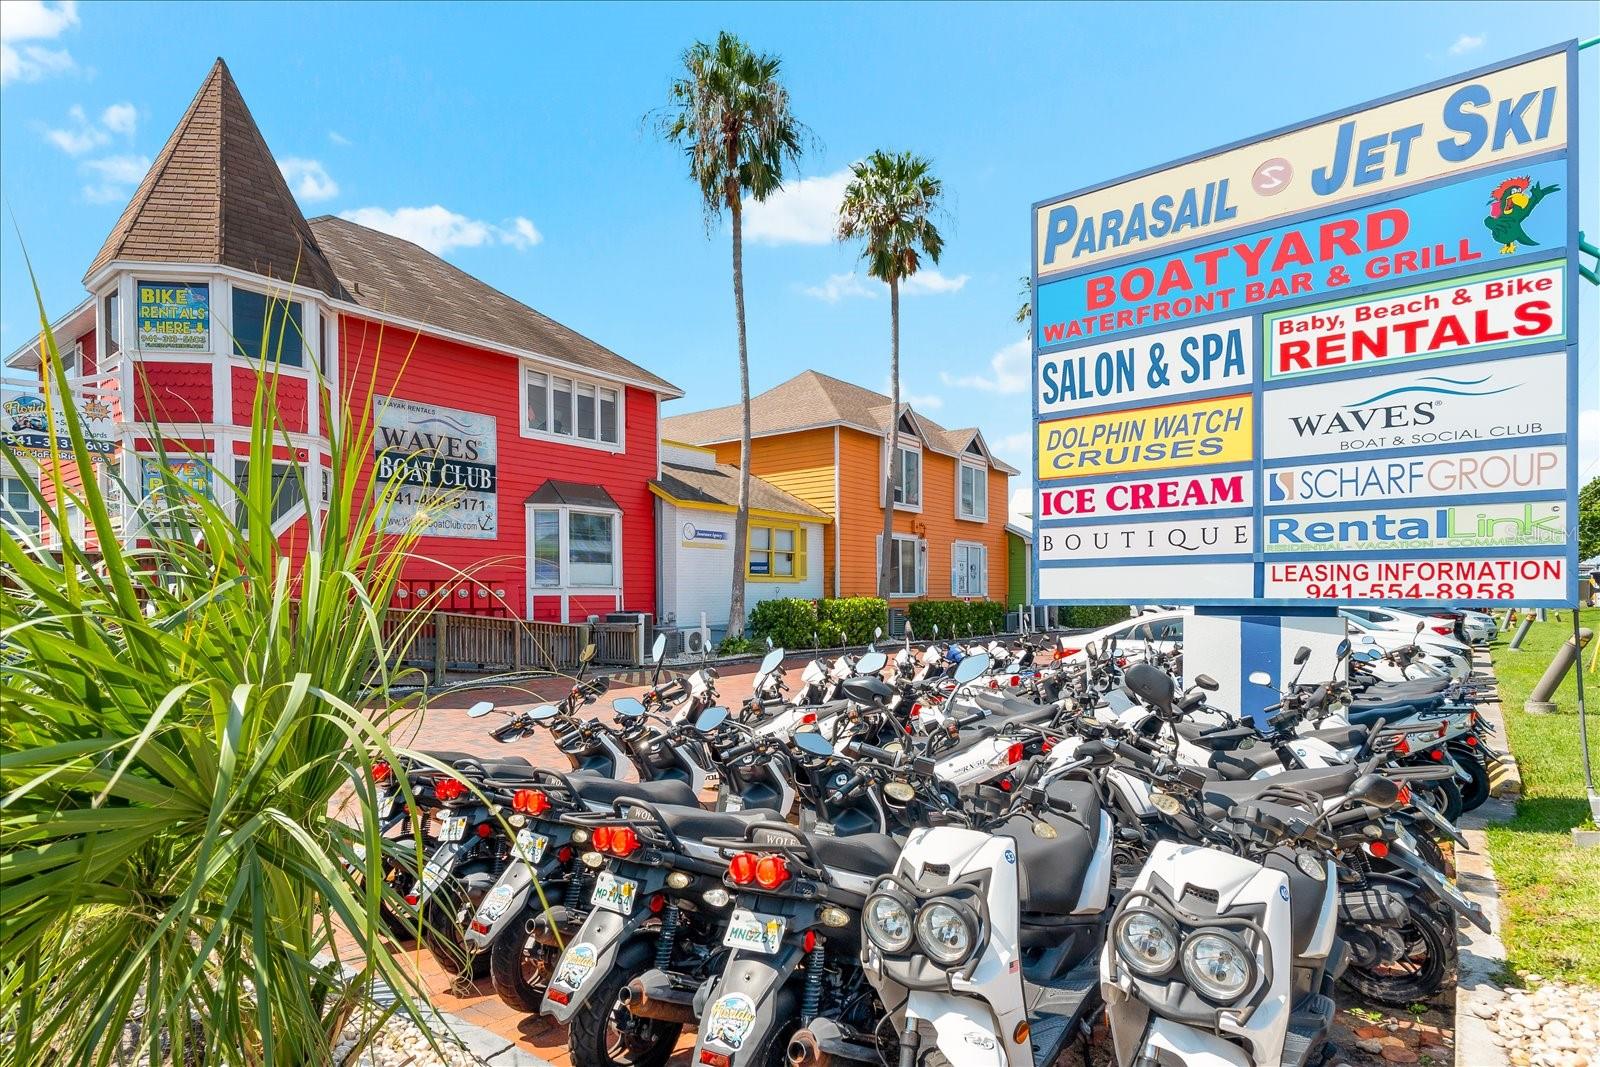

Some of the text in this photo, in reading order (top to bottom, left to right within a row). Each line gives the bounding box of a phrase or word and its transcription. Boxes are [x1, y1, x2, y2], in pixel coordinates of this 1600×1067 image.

[1043, 178, 1238, 265] PARASAIL
[1311, 121, 1423, 196] JET
[1438, 84, 1558, 162] SKI
[1086, 207, 1411, 311] BOATYARD
[141, 288, 188, 305] BIKE
[1042, 238, 1482, 343] WATERFRONT BAR & GRILL
[141, 306, 205, 320] RENTALS
[1278, 275, 1553, 336] Baby, Beach & Bike
[156, 321, 191, 335] HERE
[1279, 300, 1554, 373] RENTALS
[1042, 328, 1246, 405] SALON & SPA
[3, 400, 54, 415] Florid
[408, 404, 436, 415] RENTALS
[1046, 407, 1244, 452] DOLPHIN WATCH
[1340, 422, 1543, 451] BOAT & SOCIAL CLUB
[1052, 437, 1224, 470] CRUISES
[379, 457, 492, 489] BOAT CLUB
[1041, 476, 1244, 516] ICE CREAM
[1043, 525, 1249, 552] BOUTIQUE
[1356, 540, 1430, 550] VACATION
[1271, 560, 1561, 583] LEASING INFORMATION
[1306, 582, 1515, 599] 941-554-8958
[635, 808, 655, 821] WOL
